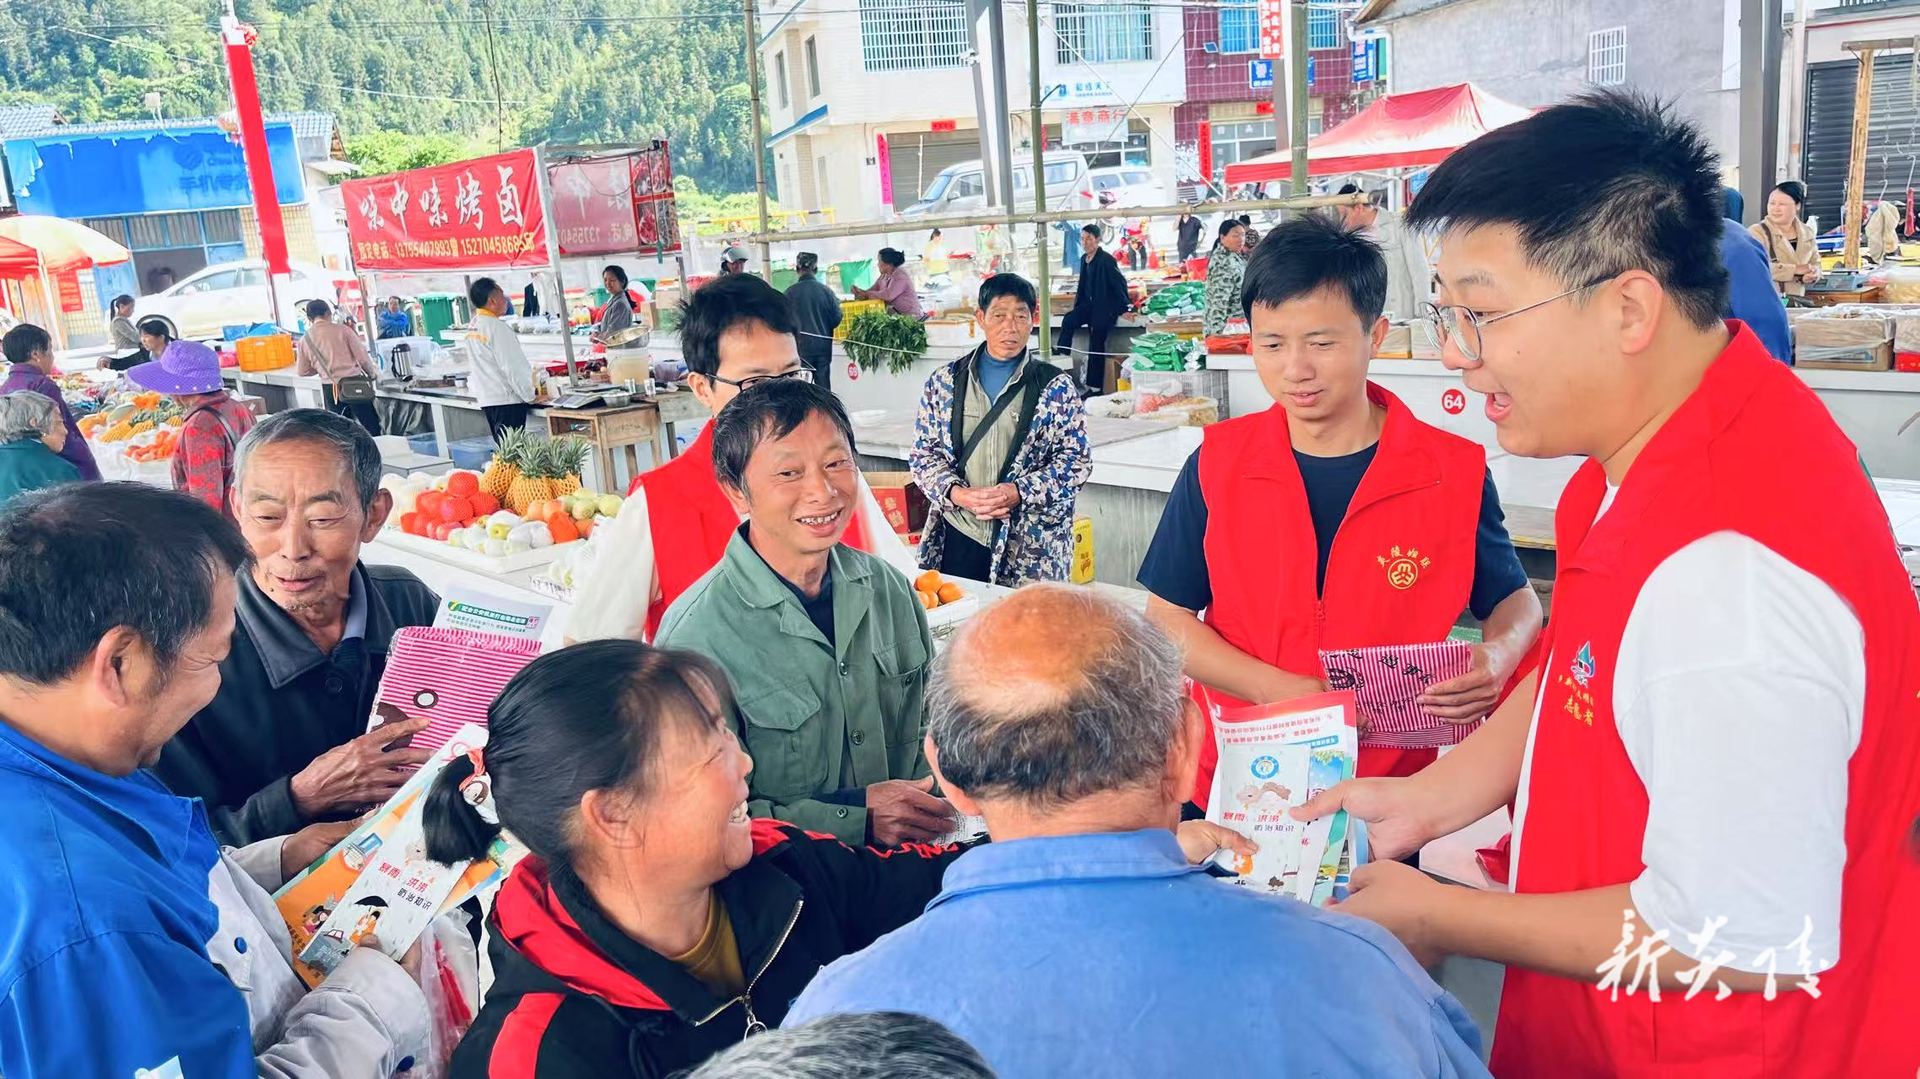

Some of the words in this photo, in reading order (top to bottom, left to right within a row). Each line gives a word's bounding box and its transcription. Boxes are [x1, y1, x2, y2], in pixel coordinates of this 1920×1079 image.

[359, 164, 524, 237] 味中味烤卤
[1443, 394, 1464, 410] 64
[1563, 694, 1594, 727] 志愿者
[1254, 824, 1295, 833] 防治知识
[397, 887, 433, 910] 防治知识
